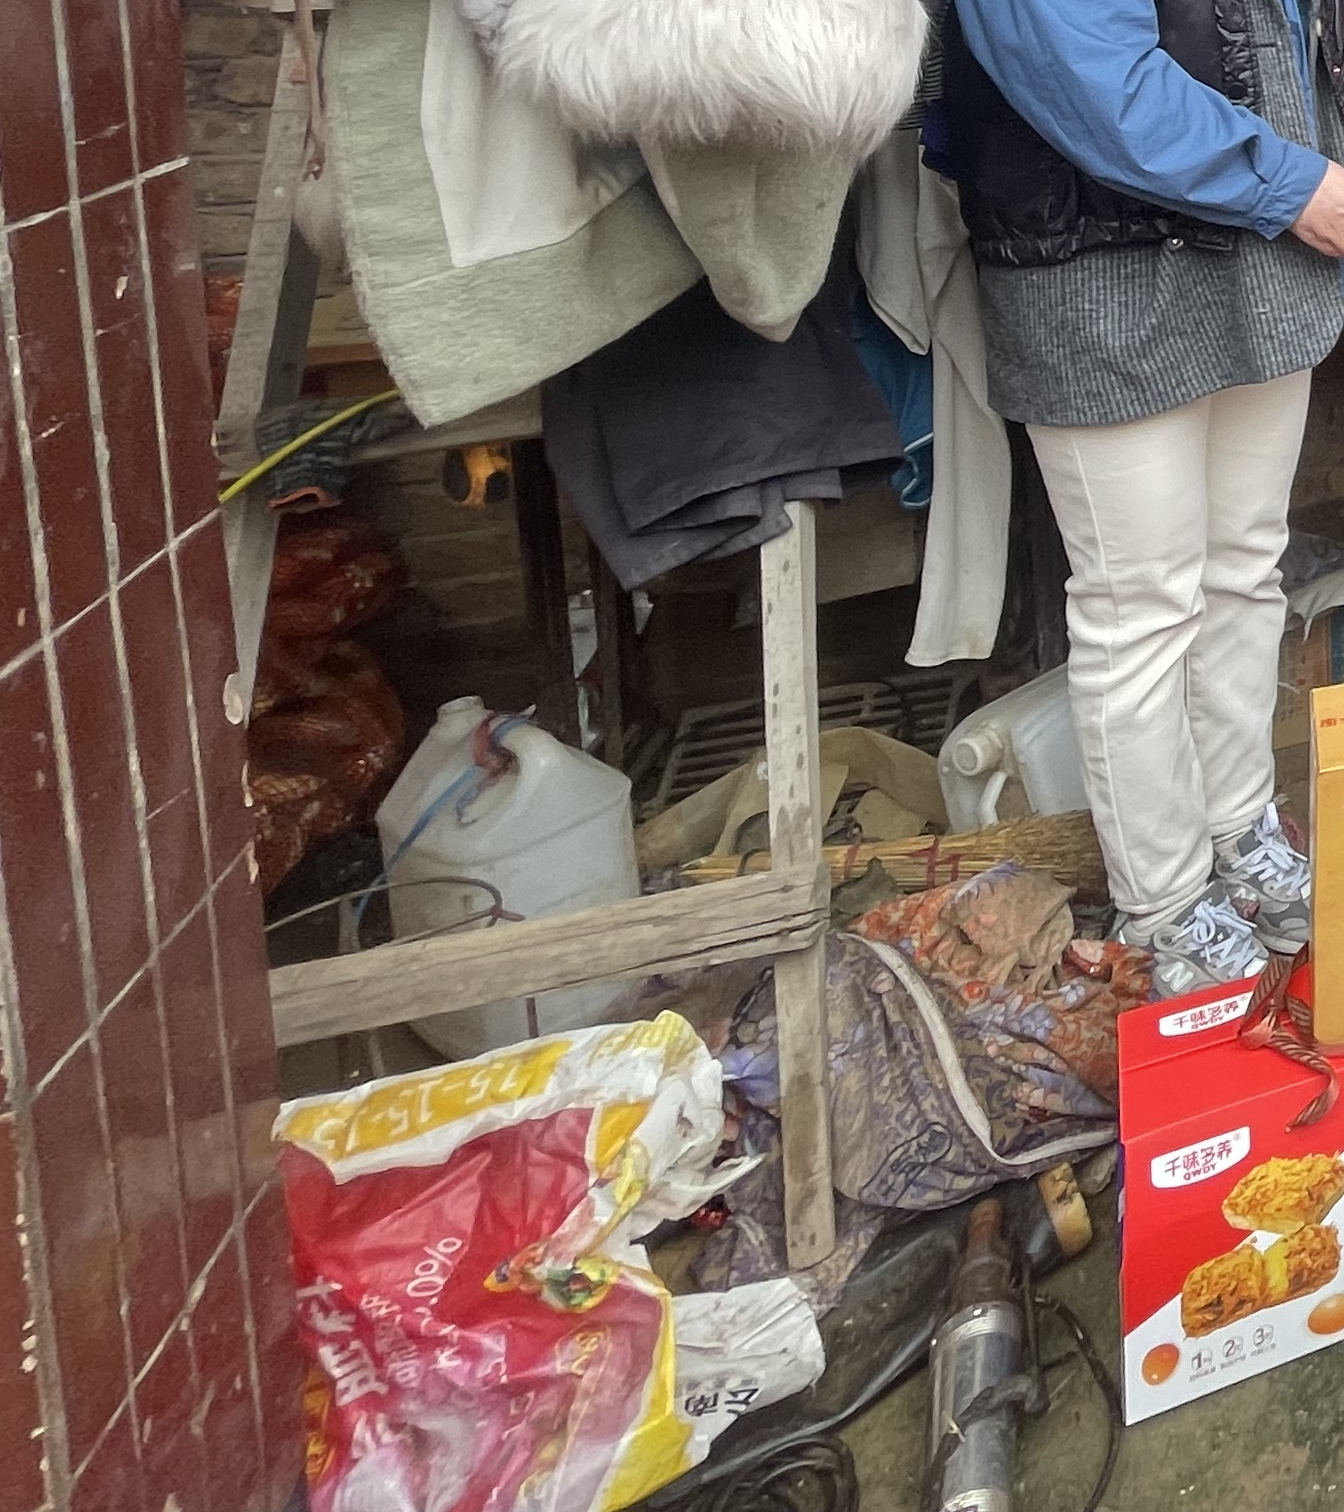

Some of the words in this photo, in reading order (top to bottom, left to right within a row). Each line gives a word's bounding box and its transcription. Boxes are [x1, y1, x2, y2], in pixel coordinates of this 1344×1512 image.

[1172, 999, 1240, 1028] 千味多养
[1164, 1140, 1233, 1178] 千味多养
